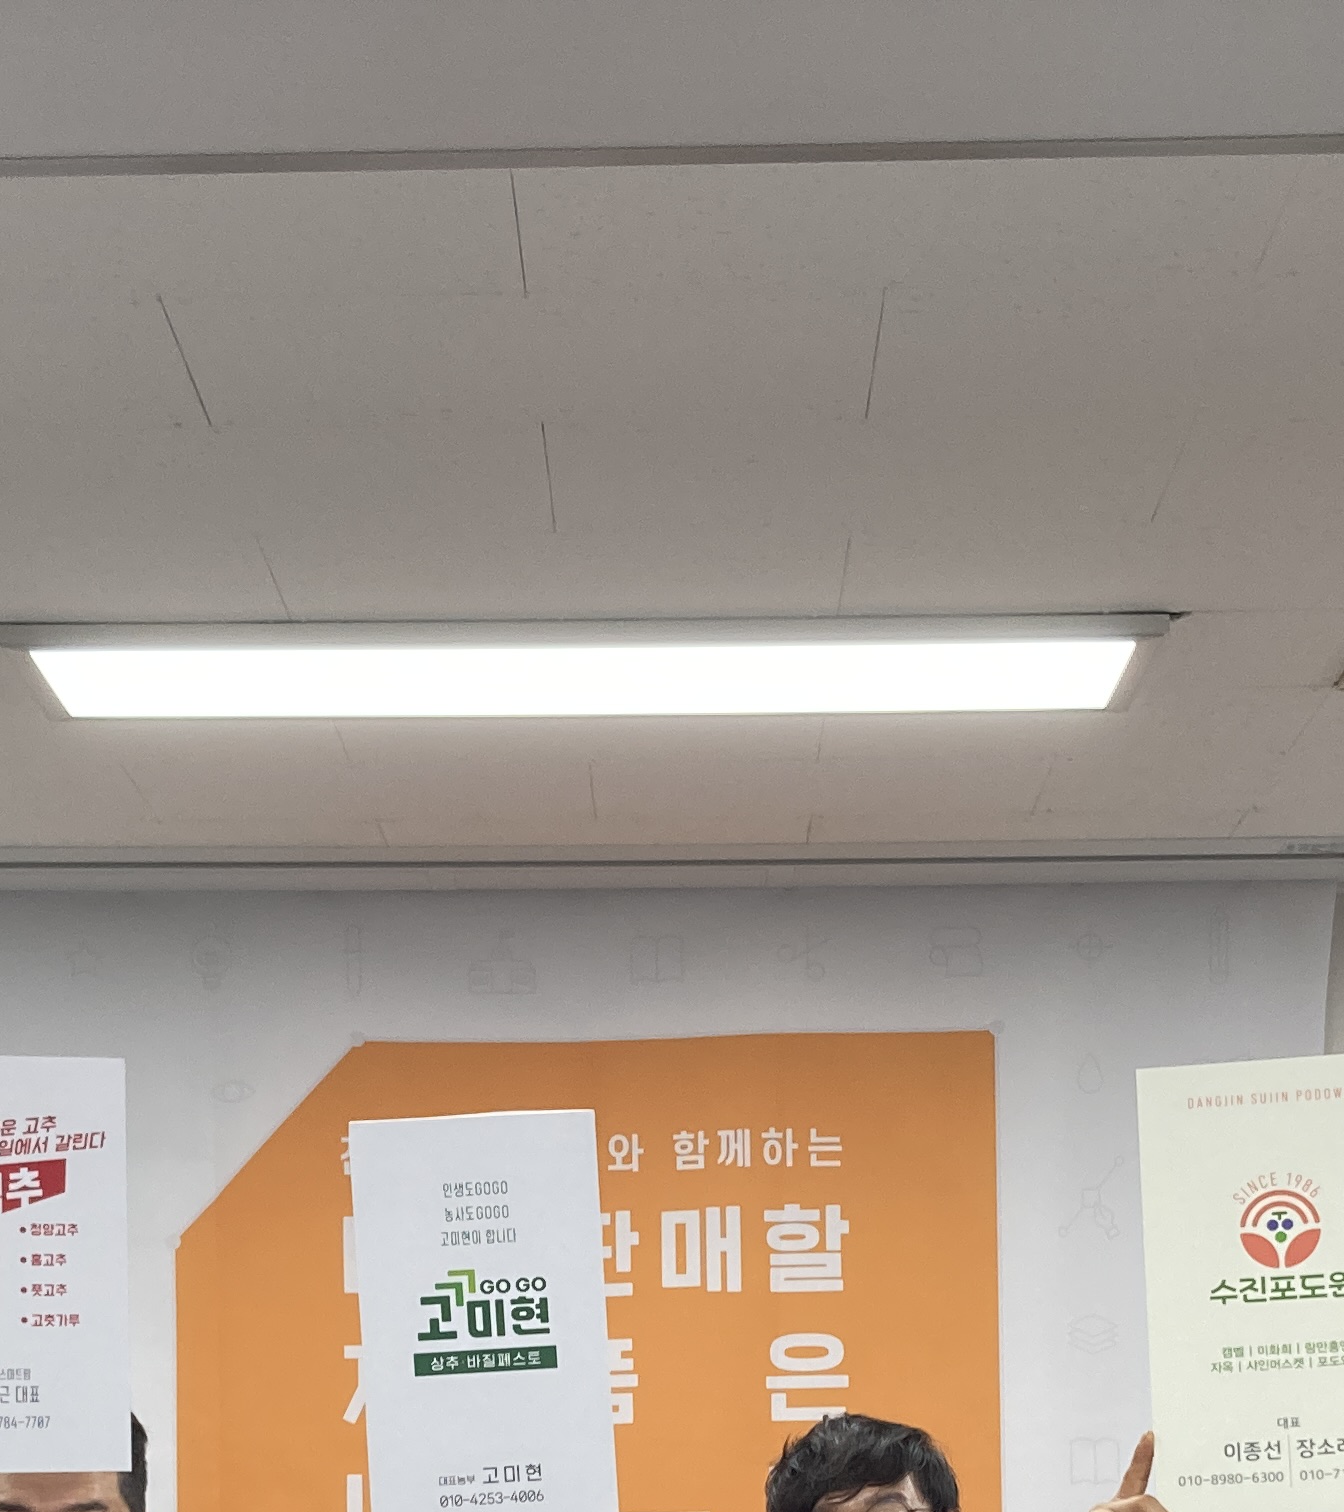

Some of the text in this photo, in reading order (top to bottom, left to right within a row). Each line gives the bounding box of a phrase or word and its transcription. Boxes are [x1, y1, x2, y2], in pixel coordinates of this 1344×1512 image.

[22, 1115, 57, 1135] 고추
[55, 1131, 106, 1152] 갈린다
[672, 1128, 844, 1171] 함께하는
[441, 1180, 509, 1199] 인생도GOGO
[1232, 1171, 1322, 1206] SINCE 1986
[443, 1204, 510, 1223] 농사도GOGO
[30, 1223, 79, 1237] 청양고추
[440, 1229, 517, 1247] 고미현이 합니다
[31, 1283, 67, 1297] 풋고추
[479, 1276, 547, 1295] GO GO
[31, 1313, 80, 1327] 고춧가루
[417, 1296, 551, 1342] 고미현
[15, 1385, 41, 1404] 대표
[1276, 1415, 1301, 1430] 대표
[1223, 1439, 1282, 1462] 이종선
[482, 1463, 544, 1486] 고미현
[439, 1490, 545, 1509] 010-4253-4006
